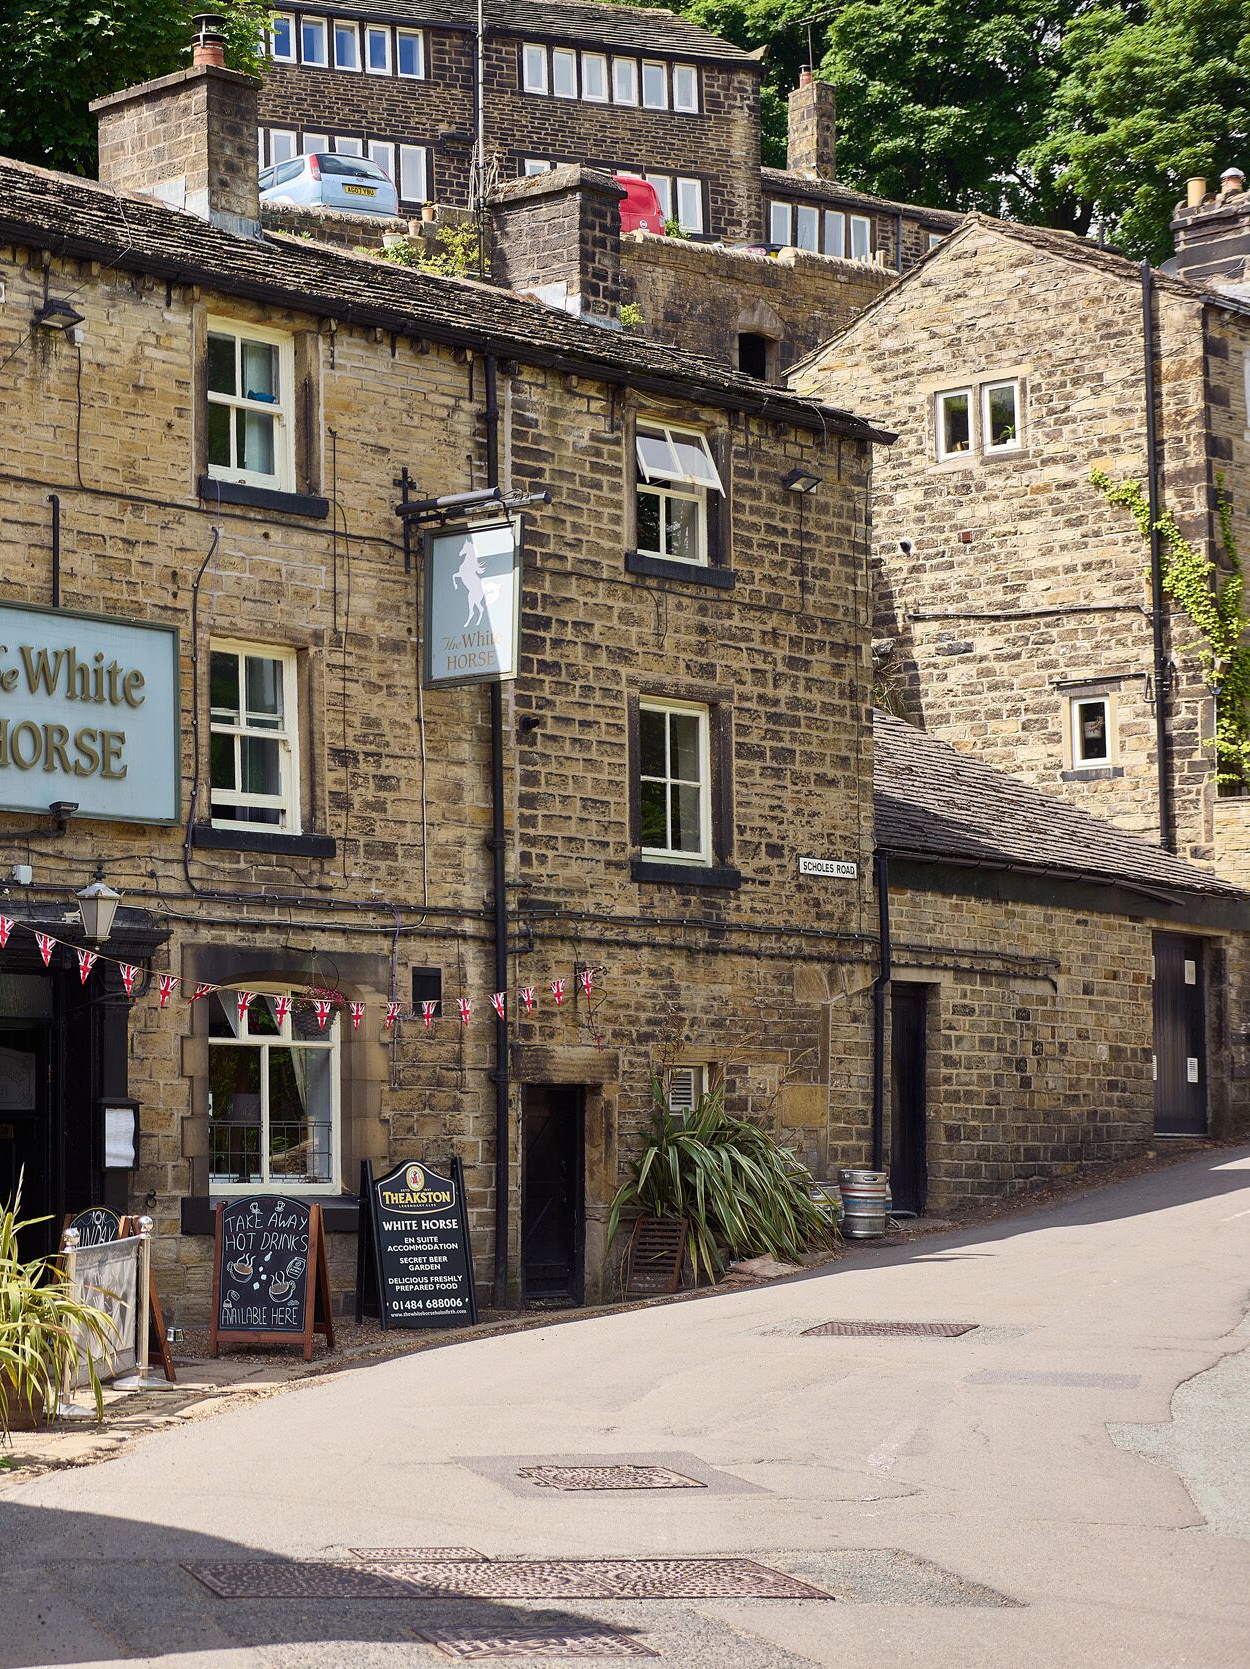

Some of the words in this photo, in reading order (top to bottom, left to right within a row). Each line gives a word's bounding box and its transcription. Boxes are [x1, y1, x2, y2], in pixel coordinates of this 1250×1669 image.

[441, 636, 462, 651] The
[446, 650, 496, 671] HORSE
[19, 645, 146, 708] White
[803, 861, 835, 873] SCHOLES
[836, 864, 855, 875] ROAD
[382, 1191, 451, 1204] THEAKSTON
[225, 1211, 263, 1232] TAKE
[267, 1212, 308, 1231] AWAY
[382, 1220, 418, 1231] WHITE
[421, 1219, 459, 1230] HORSE
[225, 1232, 256, 1251] HOT
[260, 1231, 309, 1252] DRINKS
[387, 1242, 459, 1252] ACCOMMODATION
[399, 1256, 428, 1264] SECRET
[429, 1255, 449, 1263] BEER
[408, 1263, 441, 1271] GARDEN
[388, 1276, 429, 1285] DELICIOUS
[430, 1275, 463, 1283] FRESHLY
[395, 1284, 435, 1292] PREPARED
[436, 1282, 458, 1290] FOOD
[392, 1300, 424, 1310] 01484
[425, 1298, 463, 1309] 688006
[222, 1306, 268, 1326] AVAILABLE
[271, 1306, 299, 1325] HERE
